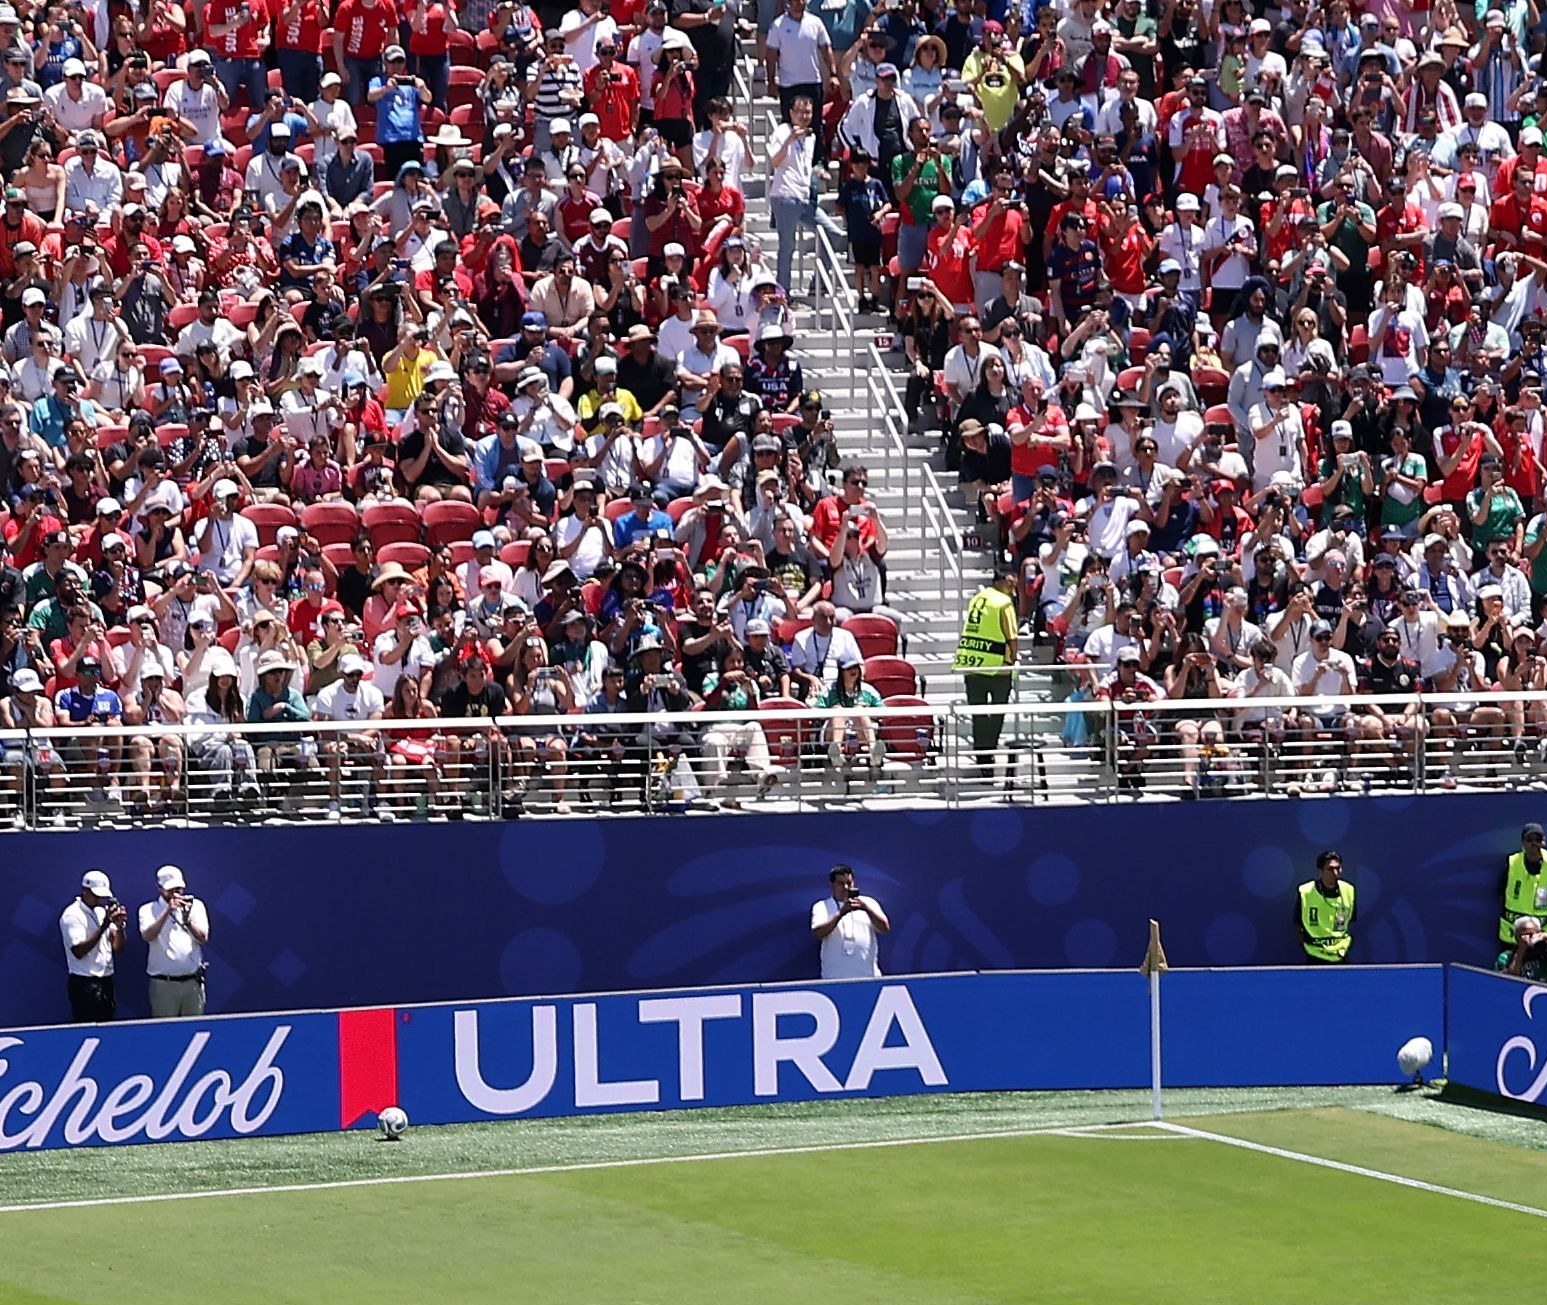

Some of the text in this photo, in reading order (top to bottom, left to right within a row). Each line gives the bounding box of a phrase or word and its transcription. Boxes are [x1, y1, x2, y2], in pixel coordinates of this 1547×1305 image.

[878, 336, 891, 347] 15
[762, 381, 788, 392] USA
[965, 536, 979, 547] 10
[960, 637, 993, 651] CURITY
[455, 985, 949, 1114] ULTRA
[0, 1024, 293, 1148] chelob
